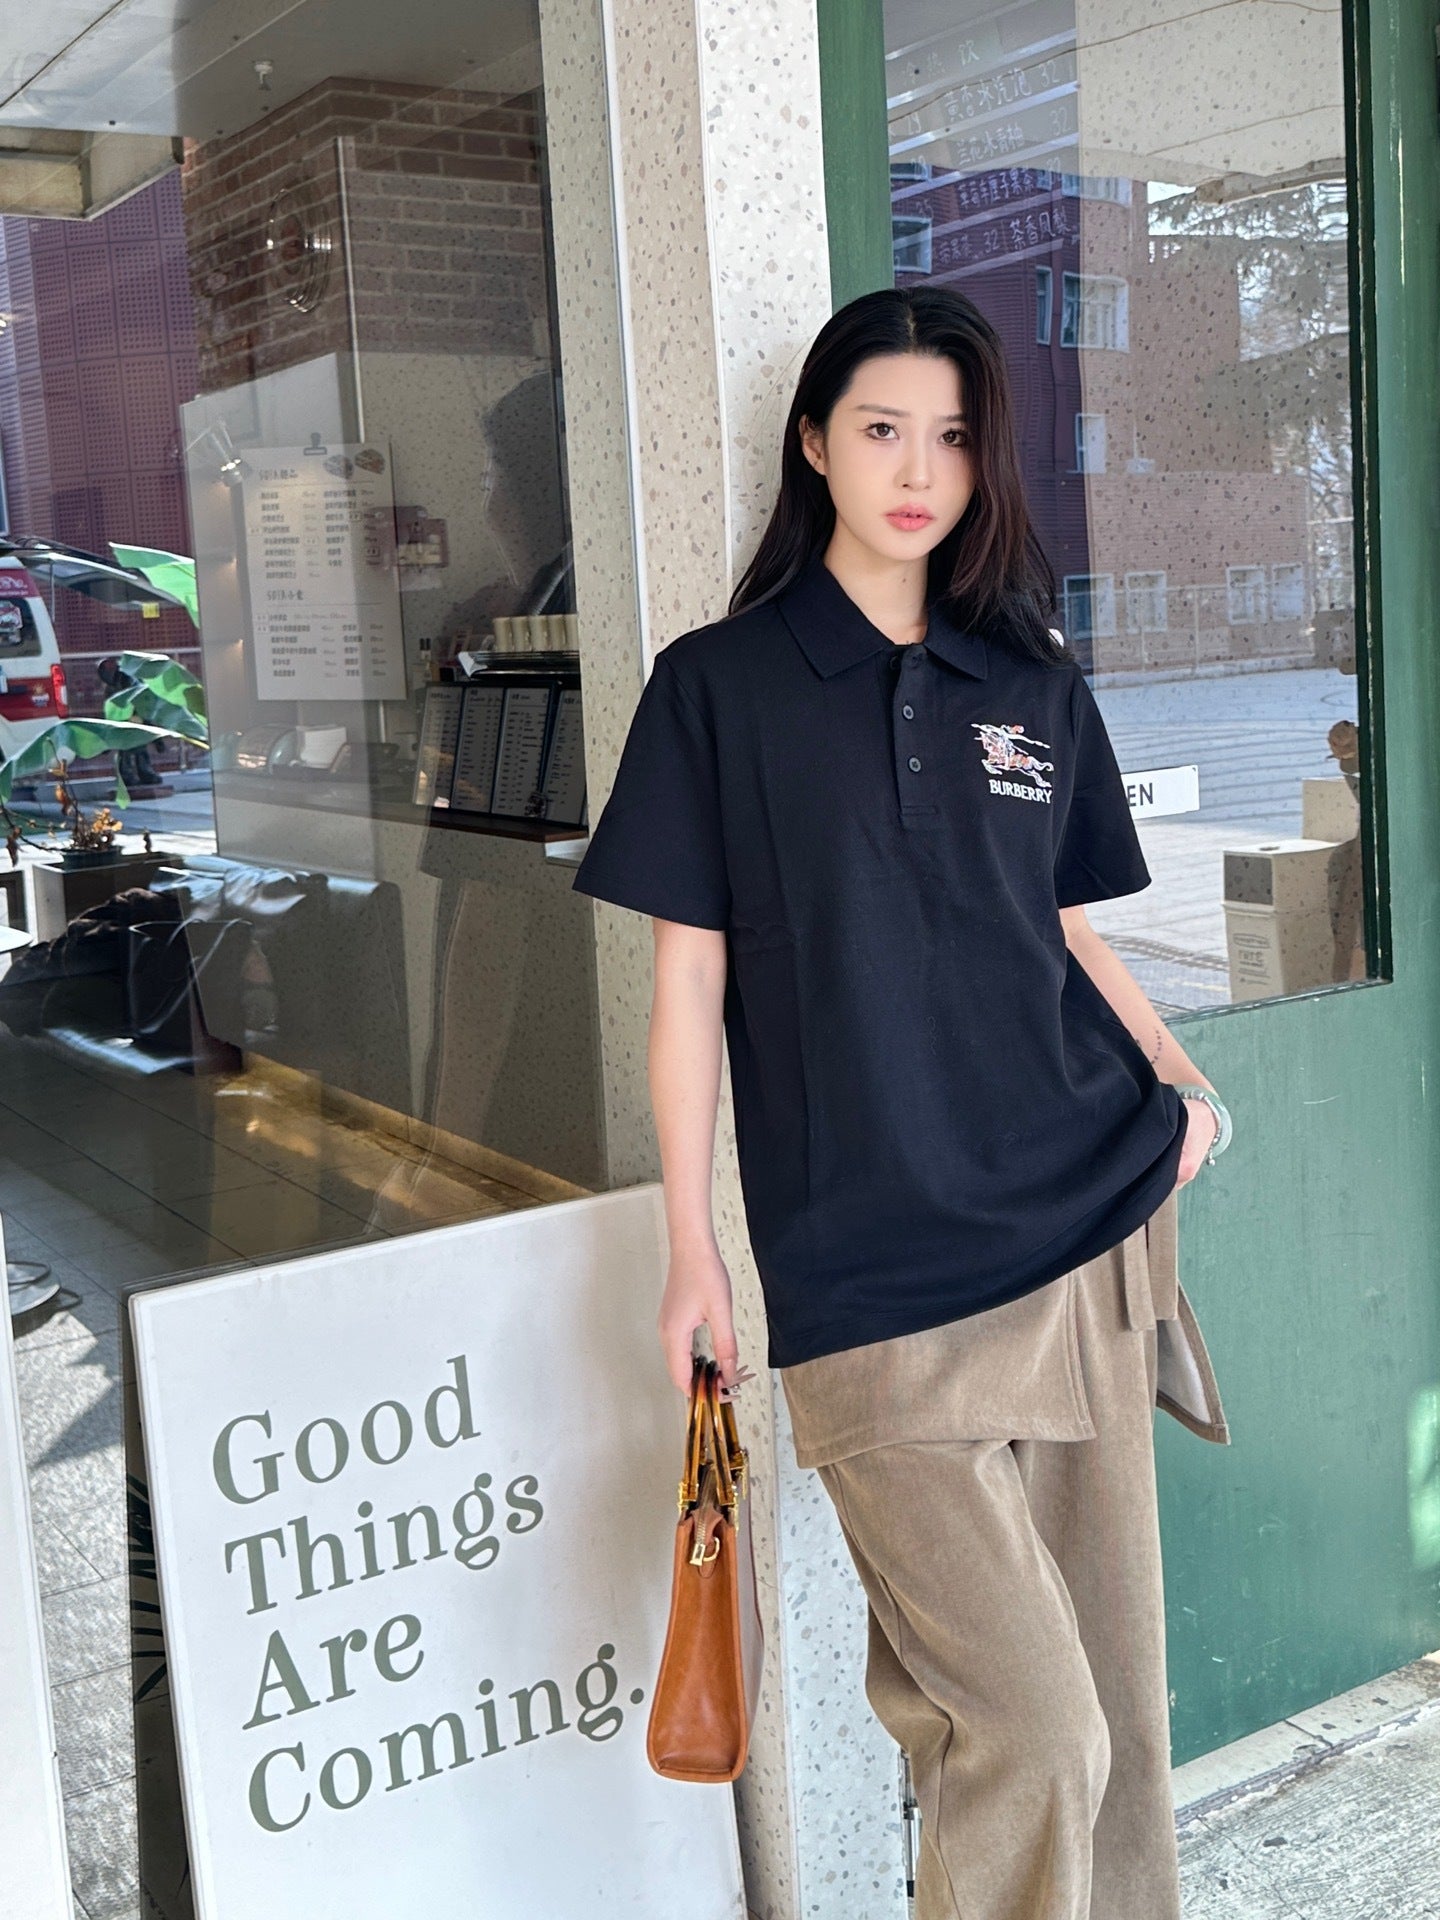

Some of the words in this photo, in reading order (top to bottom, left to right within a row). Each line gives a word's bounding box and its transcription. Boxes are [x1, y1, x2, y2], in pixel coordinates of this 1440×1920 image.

[989, 779, 1053, 803] BURBERRY
[212, 1354, 481, 1505] Good
[224, 1472, 544, 1615] Things
[242, 1613, 425, 1730] Are
[248, 1642, 644, 1833] Coming.
